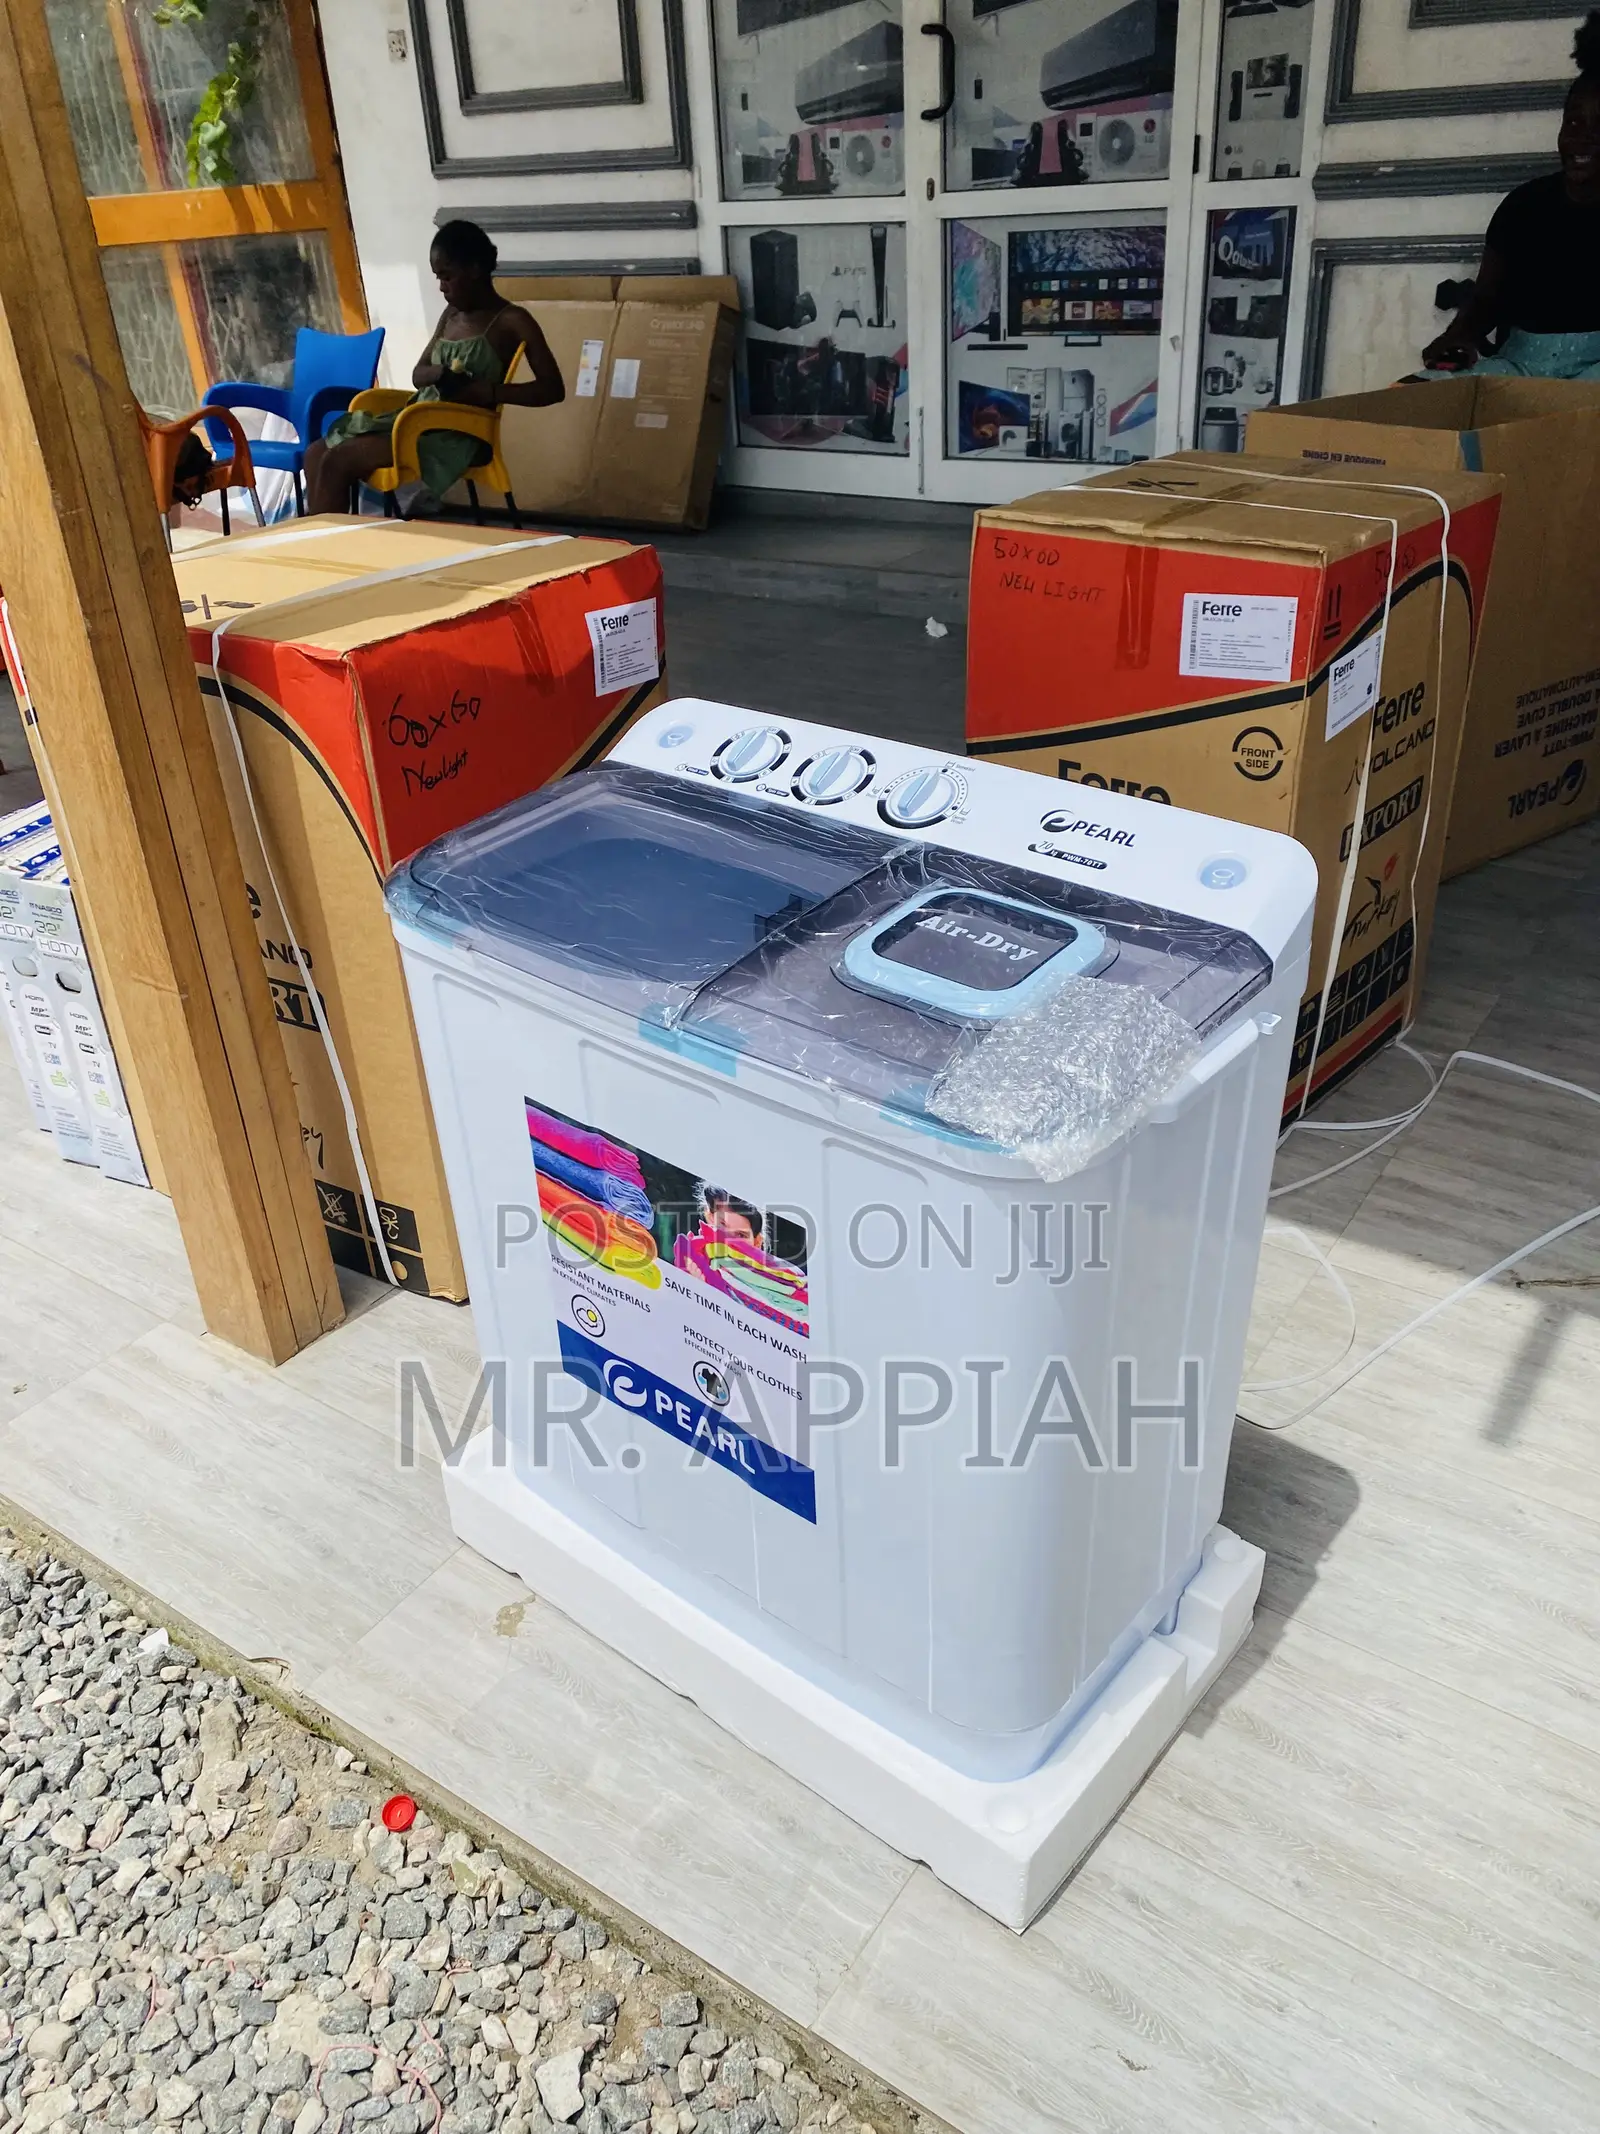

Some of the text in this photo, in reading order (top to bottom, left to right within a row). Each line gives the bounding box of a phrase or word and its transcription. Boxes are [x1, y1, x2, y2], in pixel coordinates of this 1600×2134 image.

[1044, 581, 1107, 602] LIGHT
[1202, 601, 1242, 616] Ferre
[601, 614, 629, 631] Ferre
[1333, 659, 1355, 682] Ferre
[1372, 681, 1425, 741] Ferre
[1517, 707, 1546, 728] CUVE
[1545, 709, 1598, 738] MACHINE
[1241, 747, 1276, 759] FRONT
[1494, 732, 1532, 758] LAVER
[1246, 758, 1269, 769] SIDE
[1508, 776, 1560, 819] PEARL
[1070, 820, 1137, 847] PEARL
[34, 903, 62, 914] NASCO
[40, 938, 79, 956] HDTV
[915, 915, 1039, 961] Air-Dry
[551, 1254, 651, 1313] RESISTANT MATERIALS
[560, 1270, 586, 1291] EXTREME
[587, 1287, 616, 1307] CLIMATES
[665, 1277, 808, 1364] SAVE TIME IN EACH WASH
[684, 1337, 723, 1364] EFFICIENTLY
[684, 1324, 803, 1401] PROTECT YOUR CLOTHES
[654, 1389, 756, 1475] PEARL
